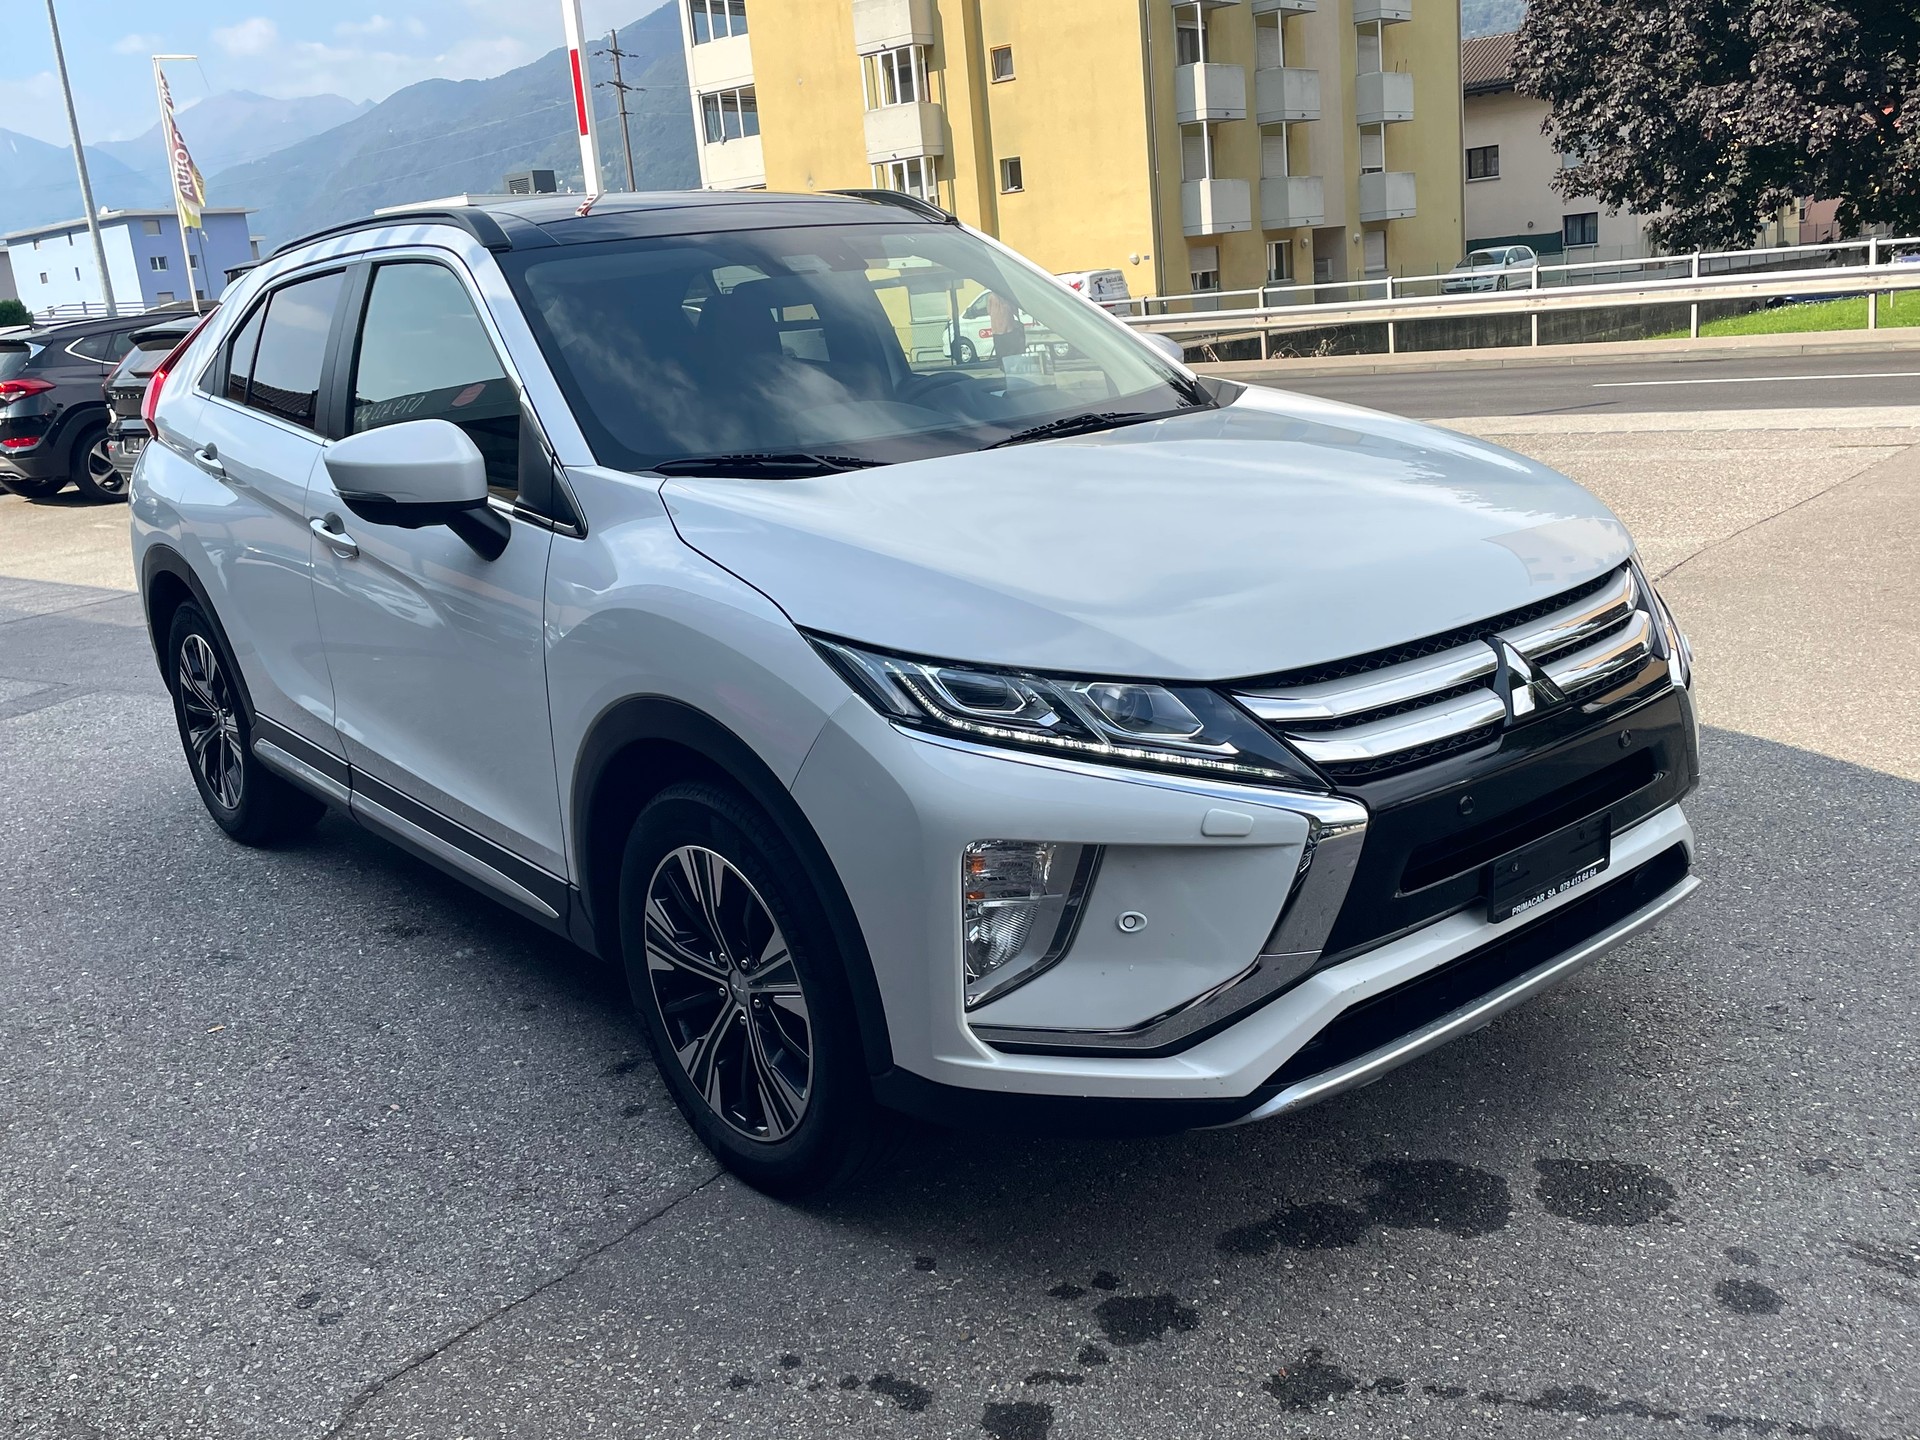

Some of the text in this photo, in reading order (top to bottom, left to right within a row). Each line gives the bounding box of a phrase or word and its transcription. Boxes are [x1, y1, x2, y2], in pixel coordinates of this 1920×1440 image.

[175, 148, 194, 197] AUTO
[1511, 893, 1545, 916] PRIMACAR
[1547, 887, 1556, 898] SA
